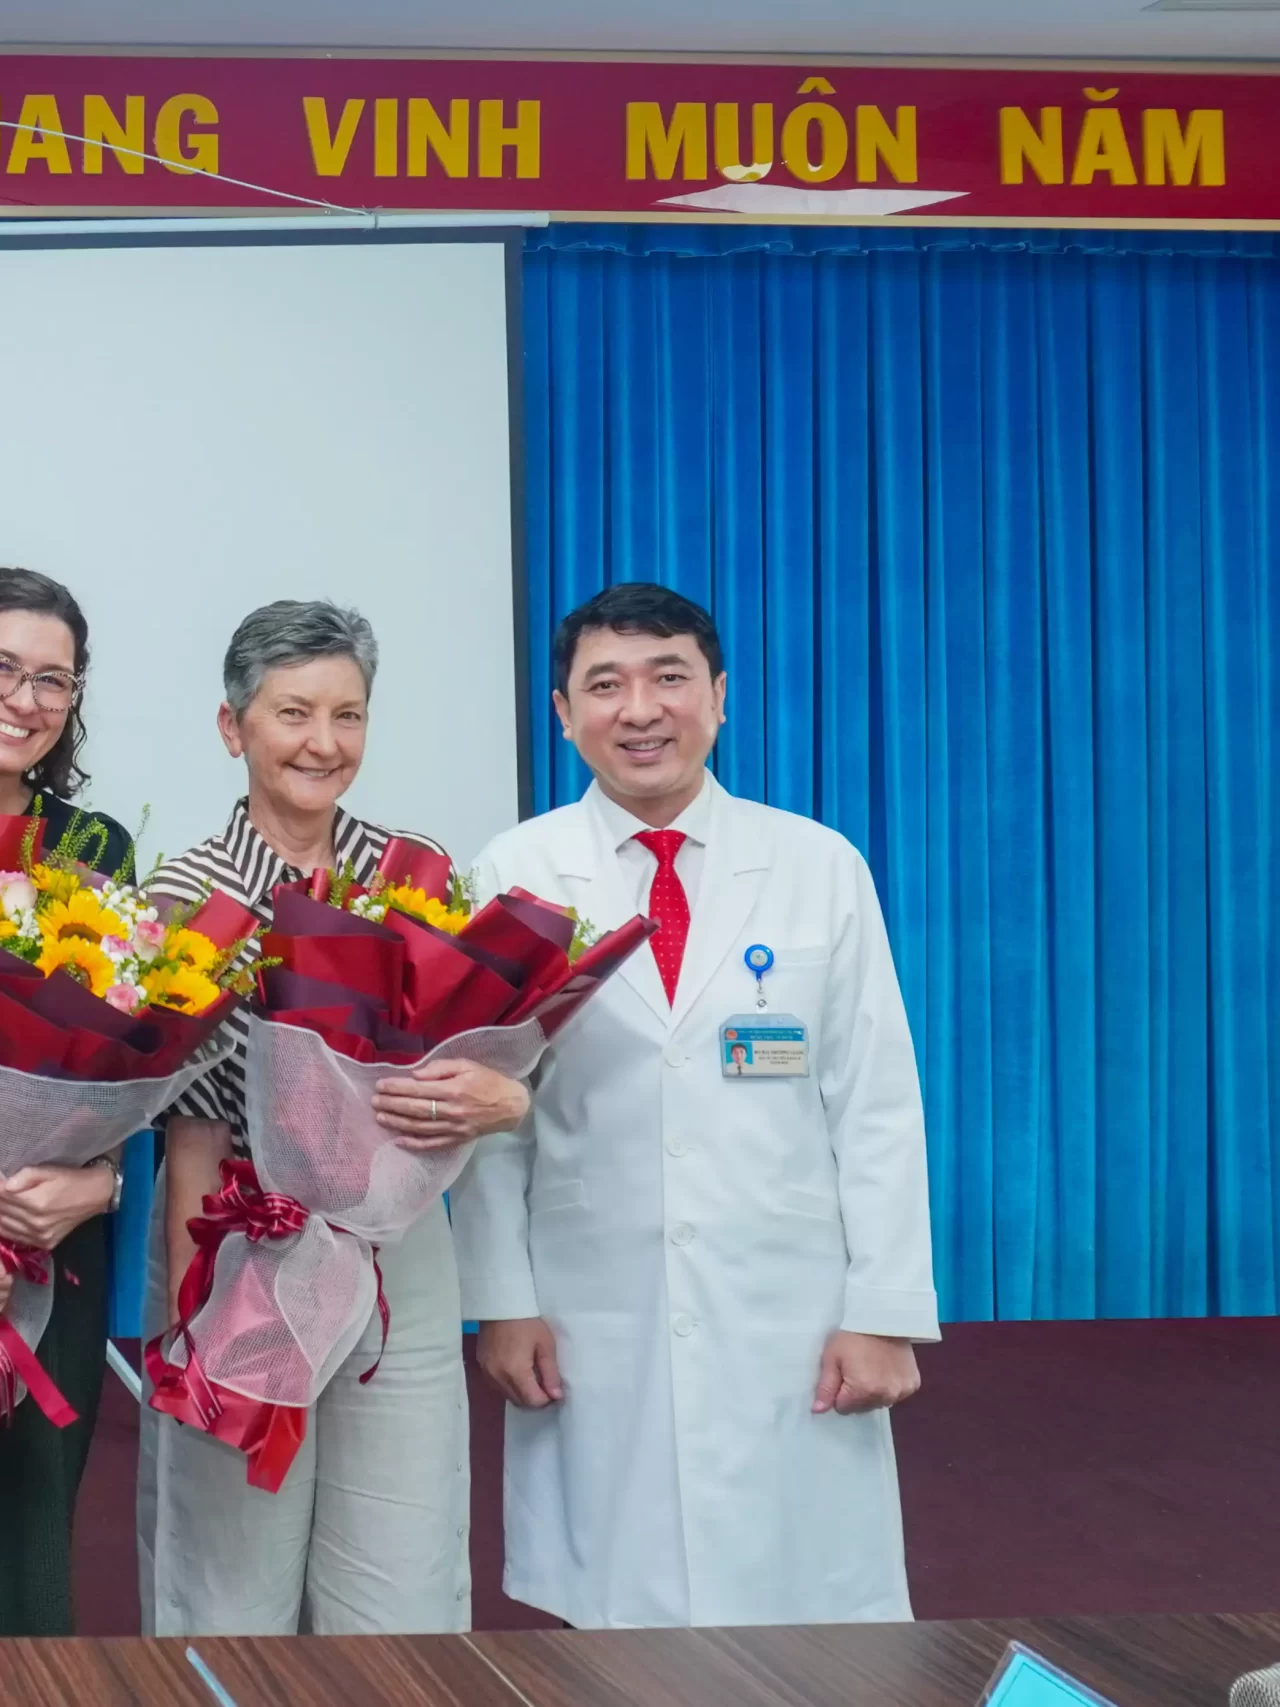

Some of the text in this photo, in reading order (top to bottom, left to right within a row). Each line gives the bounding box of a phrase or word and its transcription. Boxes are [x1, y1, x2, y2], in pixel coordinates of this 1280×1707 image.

[303, 97, 540, 179] VINH
[626, 76, 918, 183] MUÔN
[1000, 87, 1226, 187] NĂM
